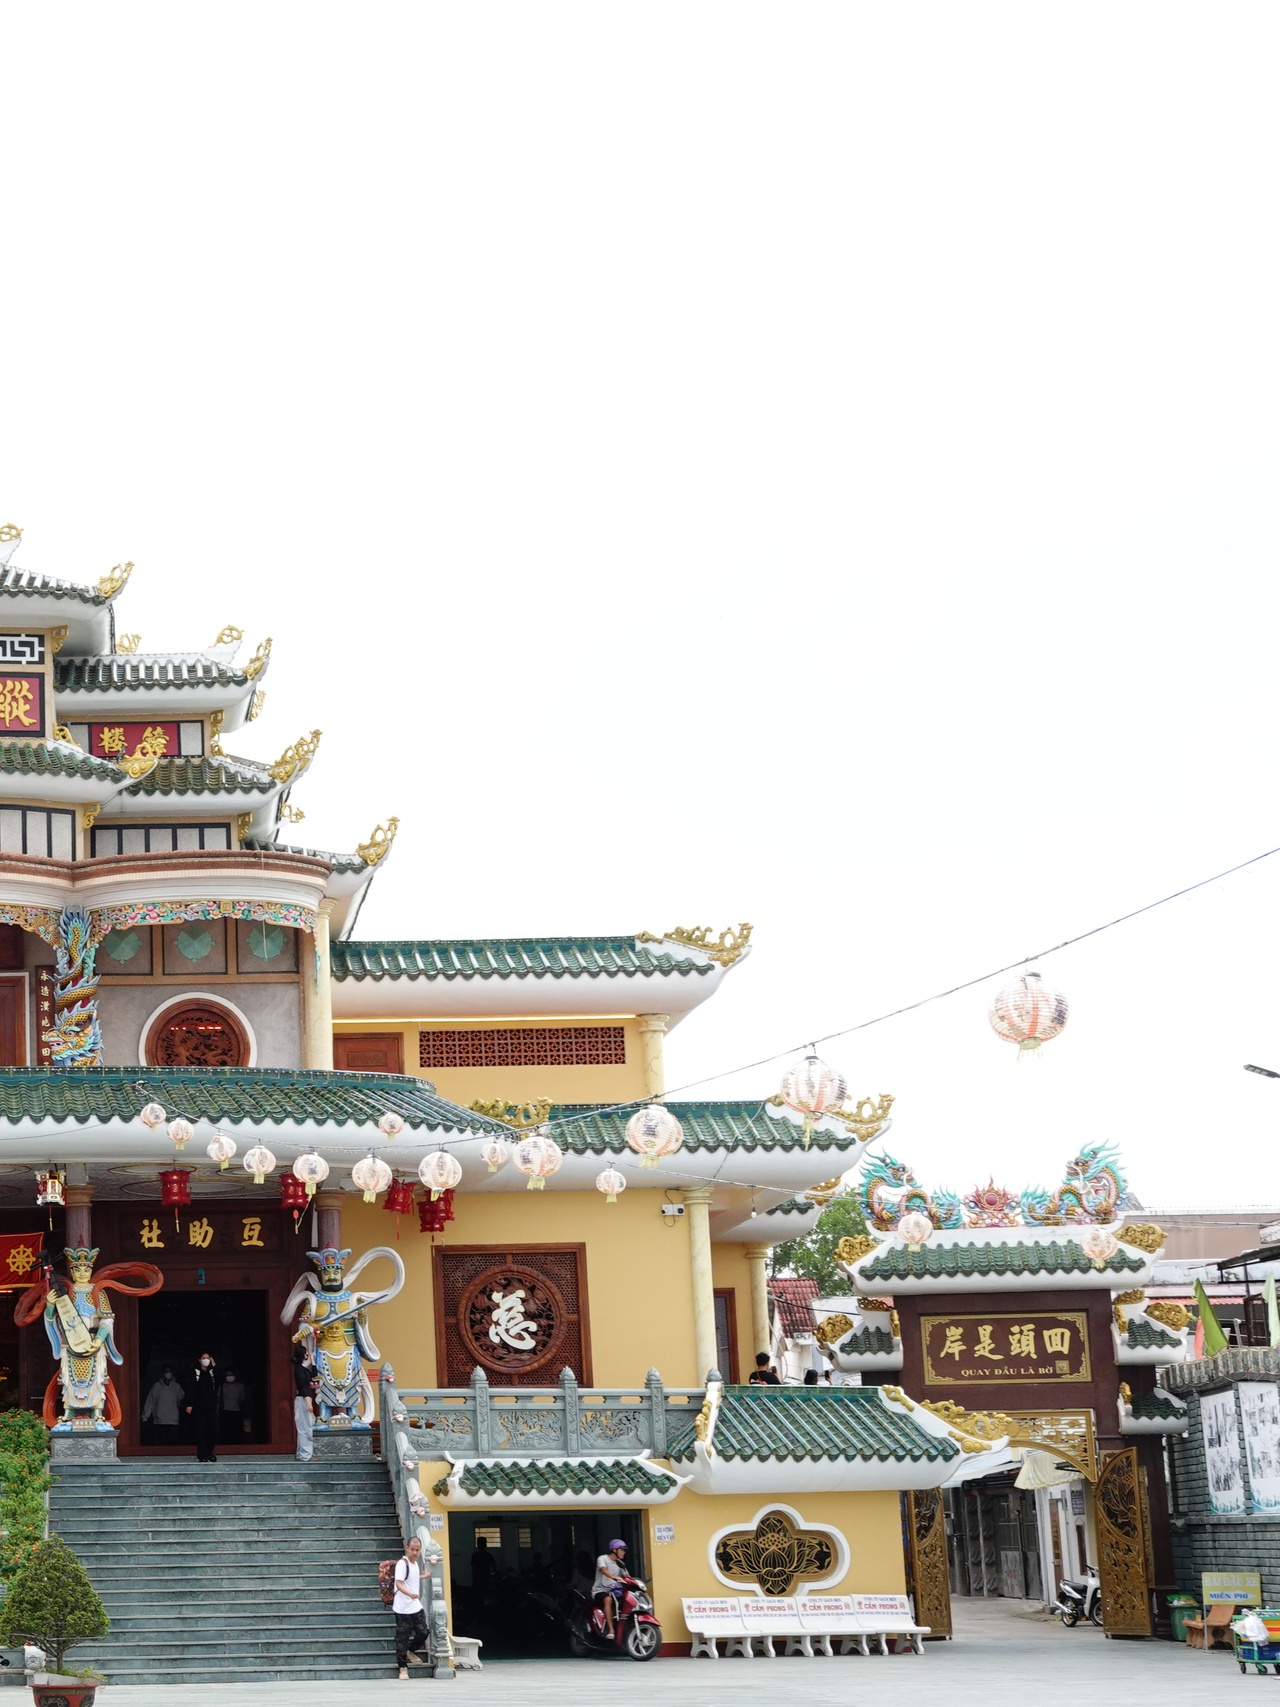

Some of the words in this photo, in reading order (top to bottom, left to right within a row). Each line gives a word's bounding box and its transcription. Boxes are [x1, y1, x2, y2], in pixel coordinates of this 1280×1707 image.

[961, 1368, 991, 1377] QUAY
[1020, 1366, 1035, 1375] LÀ
[1038, 1366, 1054, 1374] BỜ
[1246, 1577, 1258, 1587] XE
